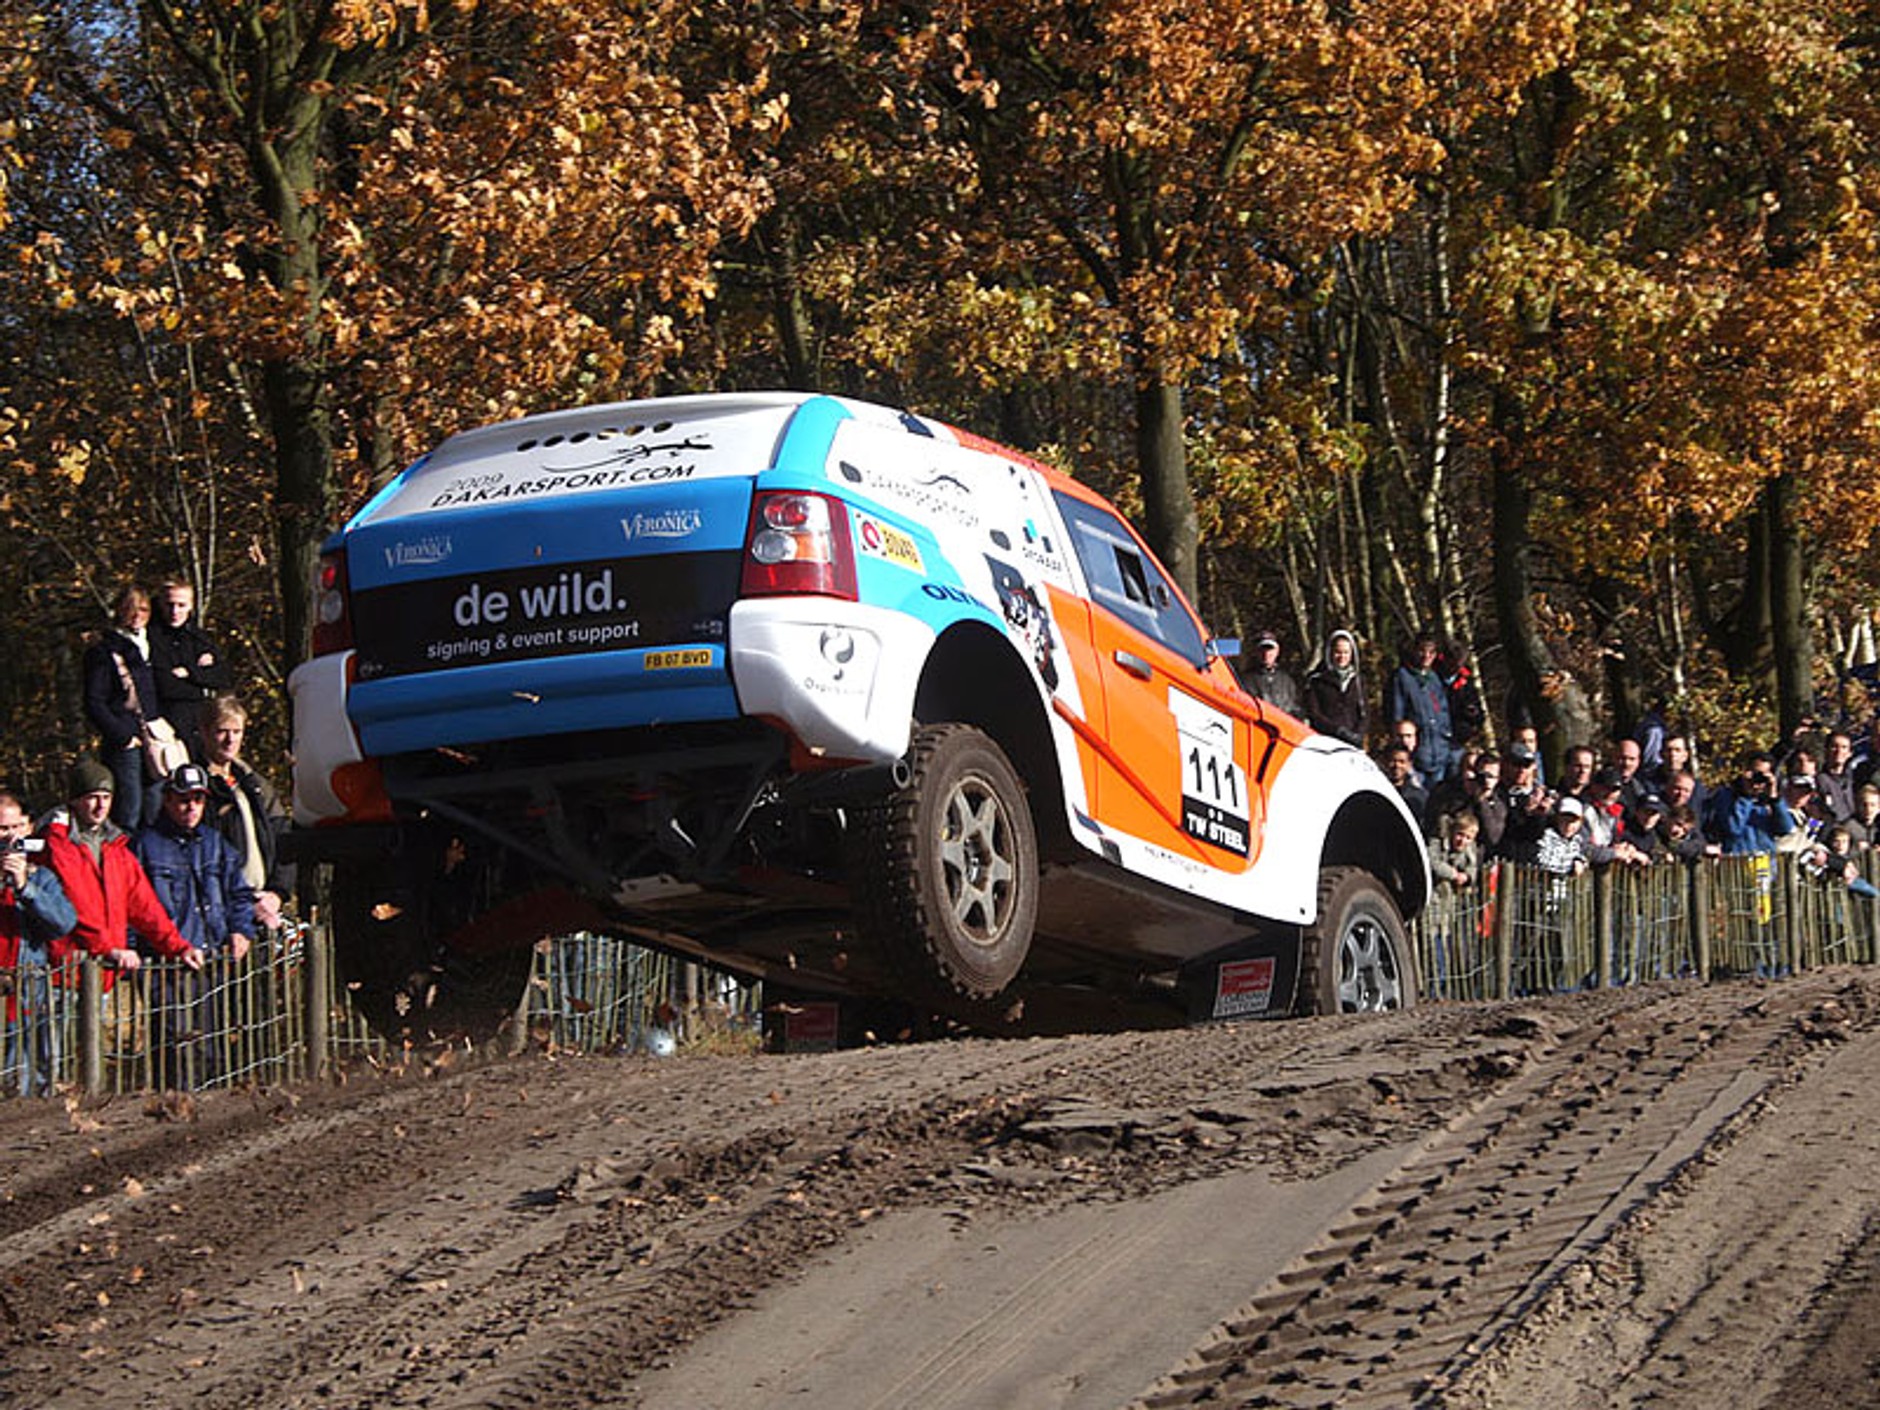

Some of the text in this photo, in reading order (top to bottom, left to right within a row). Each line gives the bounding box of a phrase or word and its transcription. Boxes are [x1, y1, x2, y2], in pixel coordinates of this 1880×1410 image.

[431, 464, 695, 507] DAKARSPORT.COM
[444, 472, 504, 492] 2009
[454, 568, 627, 627] de wild.
[426, 620, 640, 661] signing & event support
[1188, 746, 1238, 807] 111
[1186, 812, 1248, 852] TW STEEL
